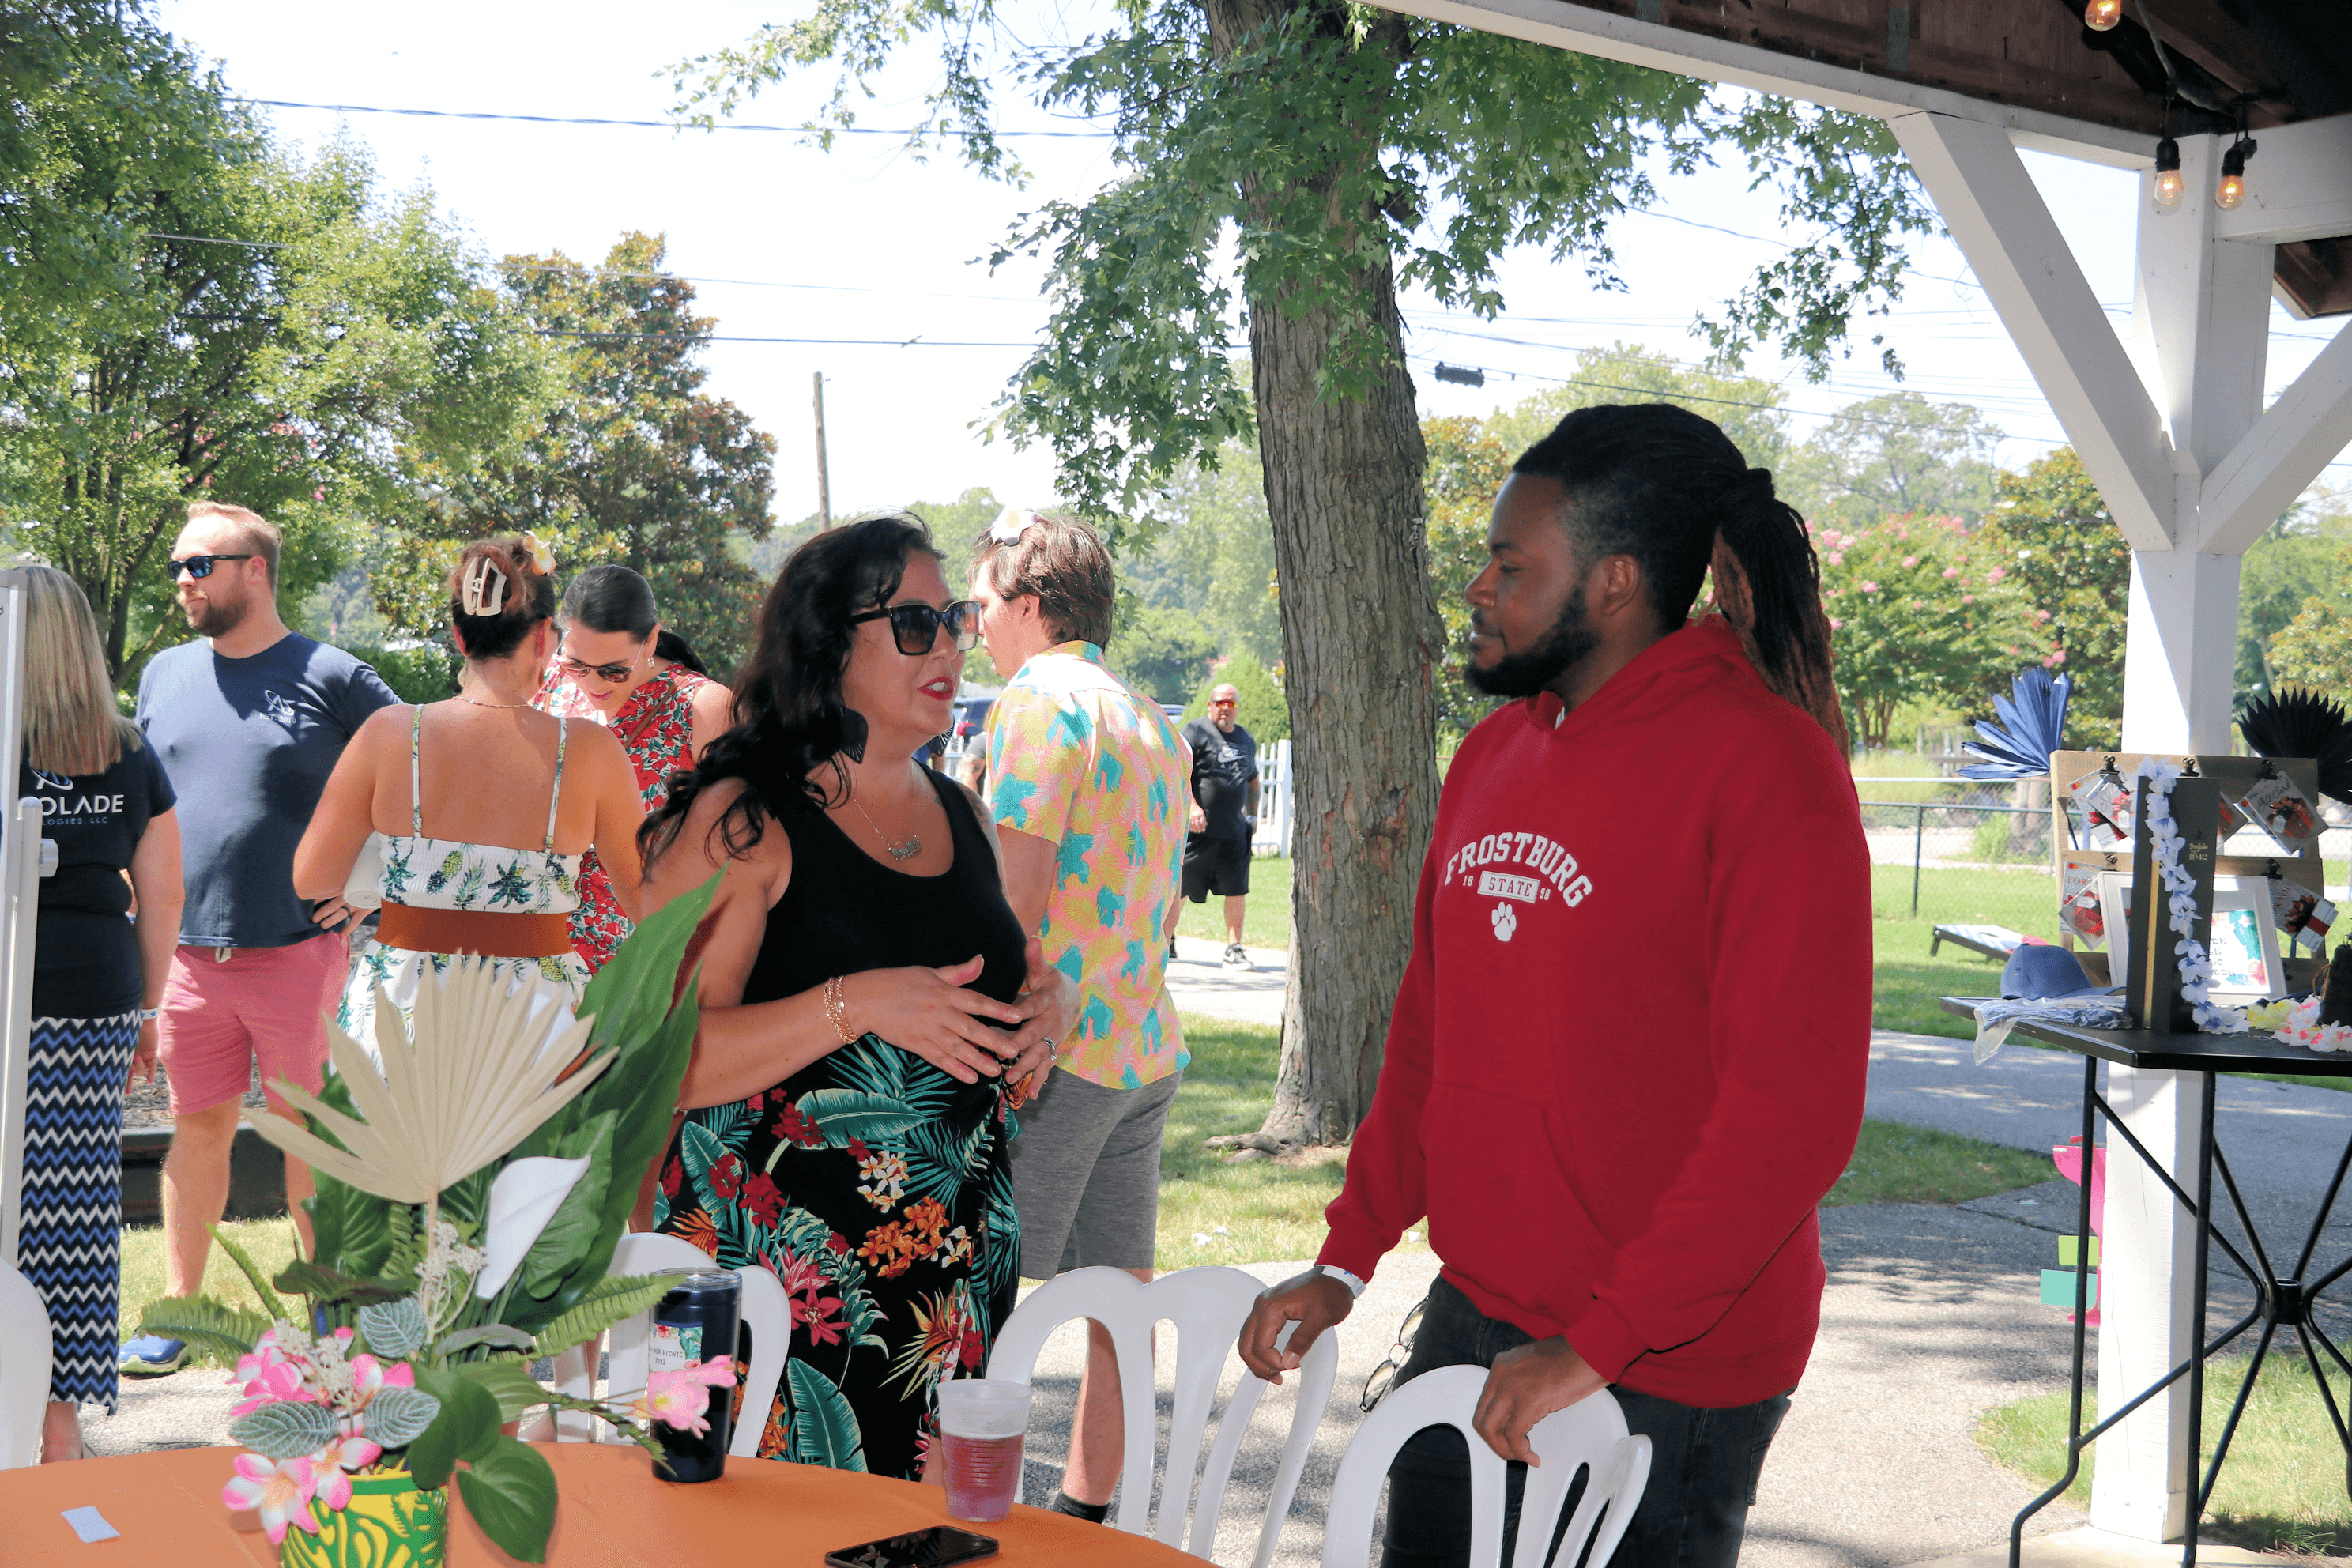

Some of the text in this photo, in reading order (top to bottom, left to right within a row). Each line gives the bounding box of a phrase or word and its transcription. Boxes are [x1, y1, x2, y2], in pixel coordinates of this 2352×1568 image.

[259, 712, 297, 725] EST. 2019
[39, 793, 125, 816] OLADE
[42, 816, 87, 826] LOGIES,
[1444, 831, 1593, 908] FROSTBURG
[1462, 875, 1551, 901] 18 STATE 98
[662, 1349, 684, 1358] PICNIC
[655, 1357, 666, 1366] 2023
